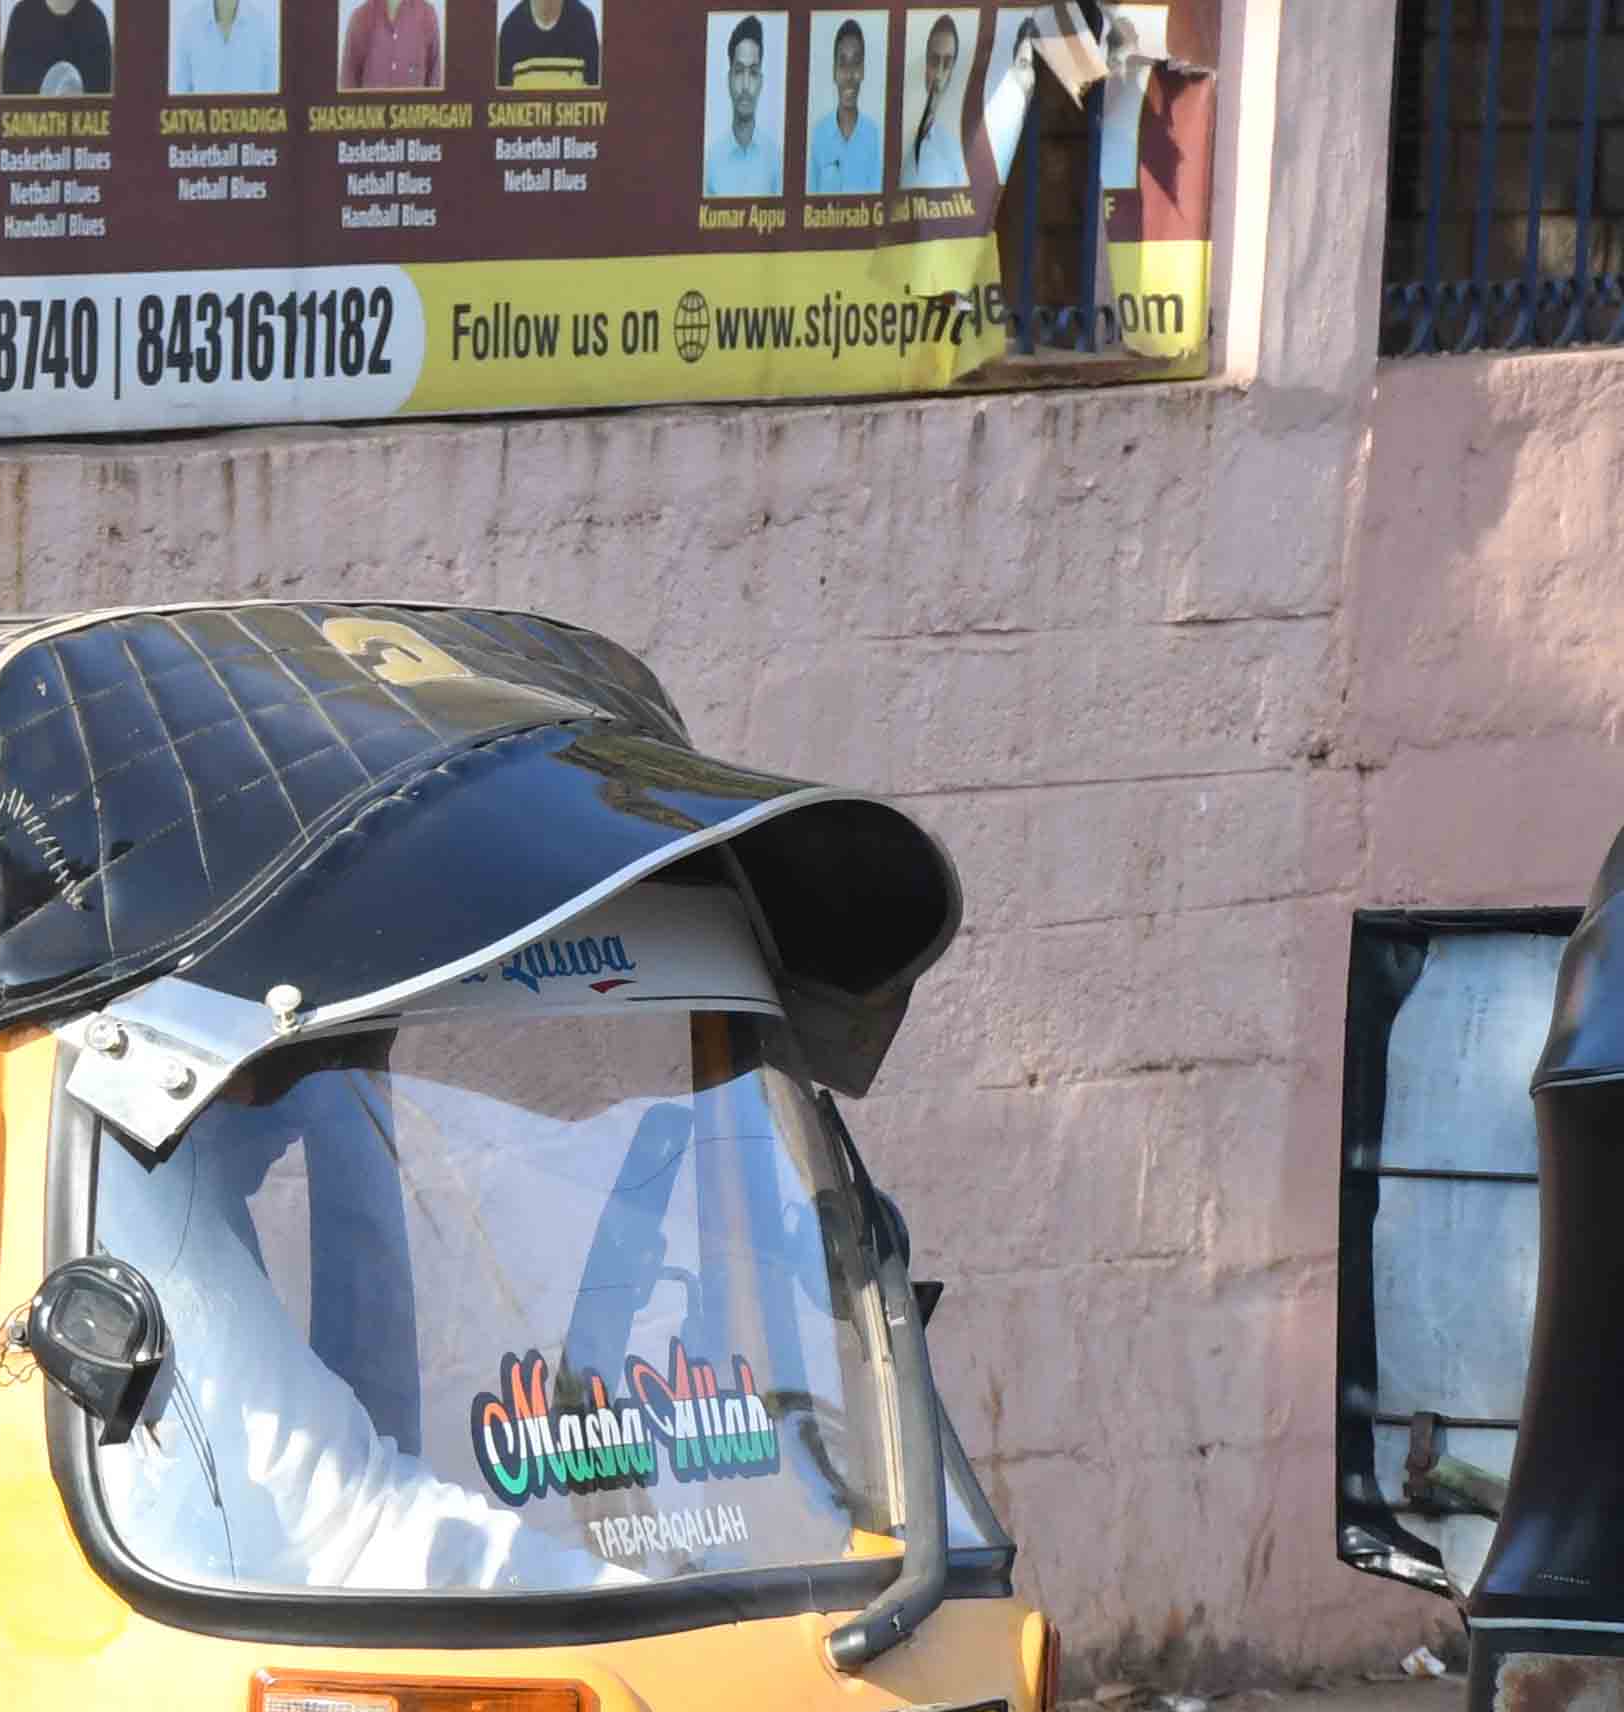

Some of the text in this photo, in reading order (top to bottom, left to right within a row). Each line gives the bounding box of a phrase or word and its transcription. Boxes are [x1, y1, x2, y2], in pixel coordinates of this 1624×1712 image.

[2, 110, 111, 137] SAINATH KALE
[160, 107, 288, 135] SATYA DEVADIGA
[309, 105, 386, 131] SHASHANK
[487, 100, 608, 128] SANKETH SHETTY
[0, 147, 111, 171] Basketball Blues
[168, 142, 277, 168] Basketball Blues
[338, 138, 442, 164] Basketball Blues
[496, 136, 598, 160] Basketball Blues
[10, 180, 101, 205] Netball Blues
[178, 175, 266, 200] Netball Blues
[347, 170, 432, 196] Netball Blues
[504, 167, 587, 192] Netball Blues
[4, 213, 105, 238] Handball Blues
[342, 203, 436, 228] Handball Blues
[699, 204, 786, 234] Kumar Appu
[803, 202, 870, 228] Bashirsab
[137, 287, 393, 386] 8431611182
[453, 302, 560, 361] Follow
[574, 306, 609, 356] us
[622, 303, 659, 354] on
[471, 1336, 780, 1506] Masha Allah
[588, 1504, 749, 1558] TABARAQALLAH
